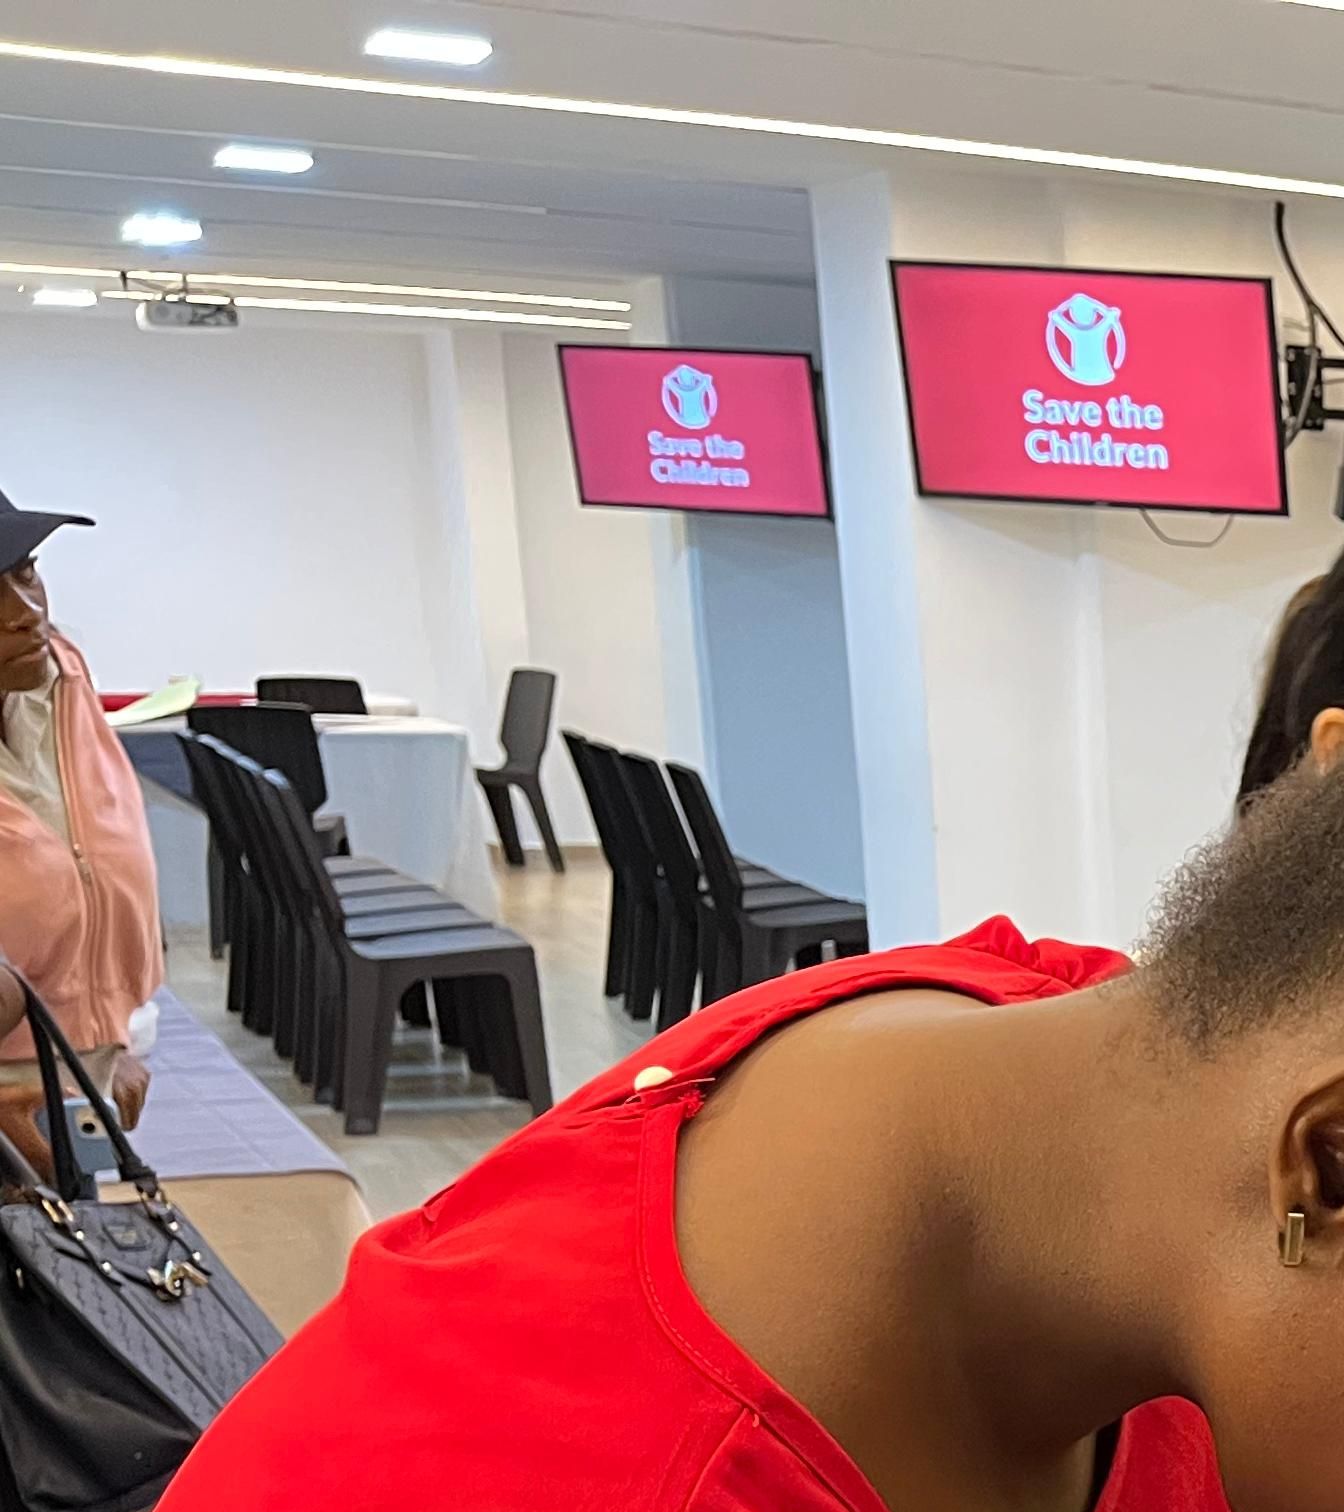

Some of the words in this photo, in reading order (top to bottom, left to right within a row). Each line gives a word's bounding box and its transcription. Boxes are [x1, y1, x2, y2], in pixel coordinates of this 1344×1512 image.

[1023, 389, 1102, 427] Save
[1106, 394, 1164, 430] the
[1025, 429, 1169, 470] Children
